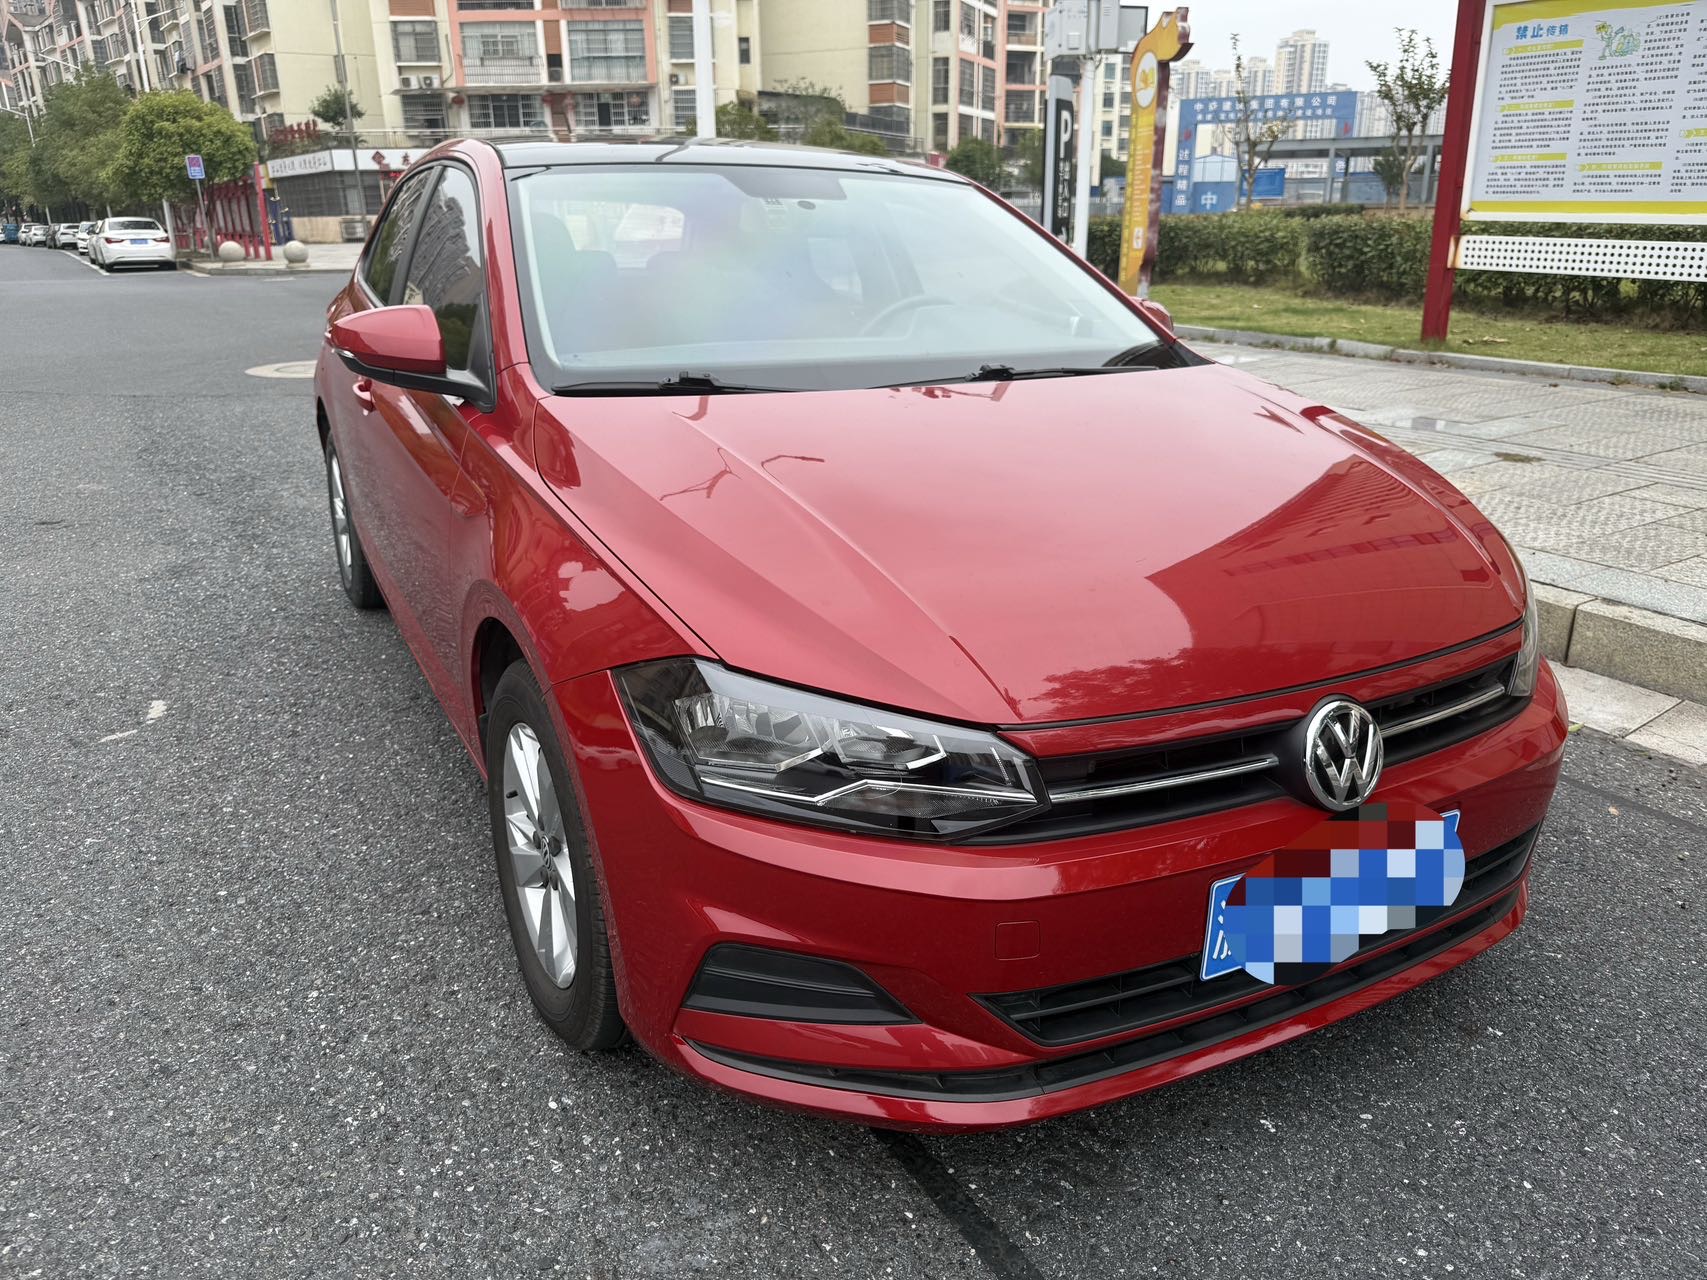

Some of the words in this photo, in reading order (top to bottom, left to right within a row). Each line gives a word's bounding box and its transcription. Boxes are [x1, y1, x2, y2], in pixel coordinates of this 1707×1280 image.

[1515, 23, 1569, 40] 禁止传销
[1060, 110, 1073, 158] P
